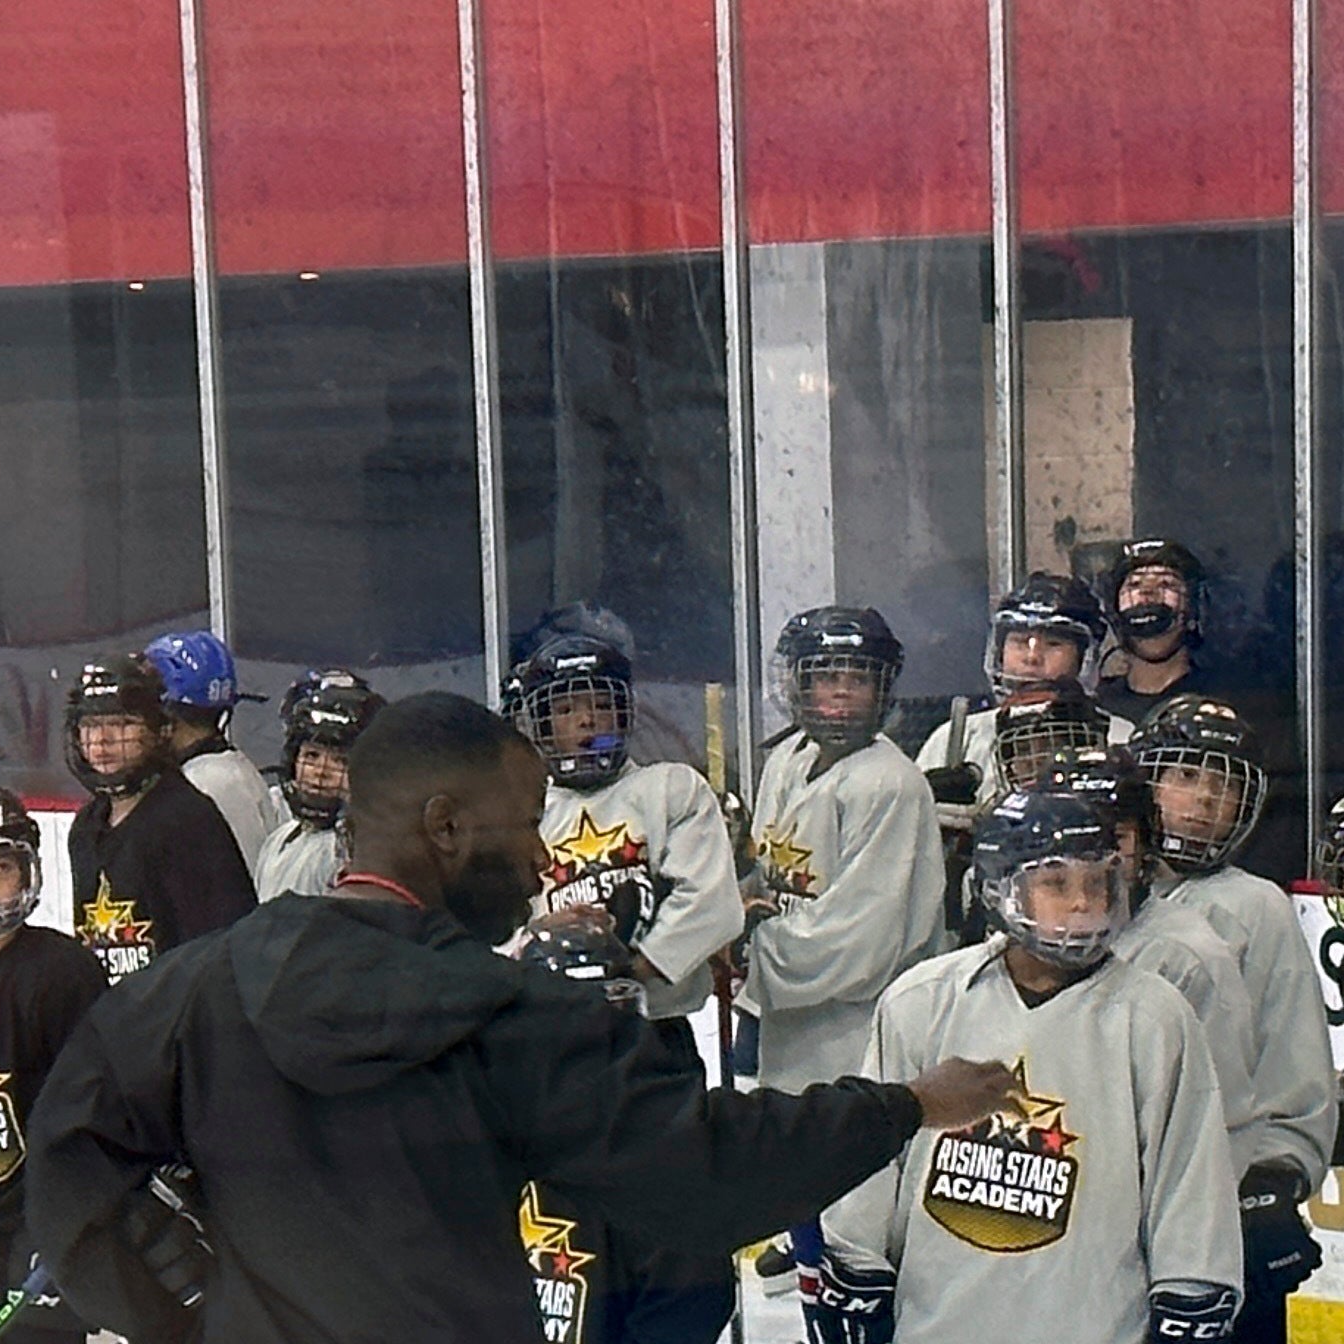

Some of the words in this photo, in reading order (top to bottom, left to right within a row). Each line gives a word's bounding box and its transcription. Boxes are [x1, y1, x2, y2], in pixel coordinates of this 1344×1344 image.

[108, 945, 151, 975] STARS
[936, 1137, 1005, 1184] RISING
[1003, 1150, 1072, 1197] STARS
[931, 1176, 1064, 1220] ACADEMY
[534, 1277, 576, 1319] TARS
